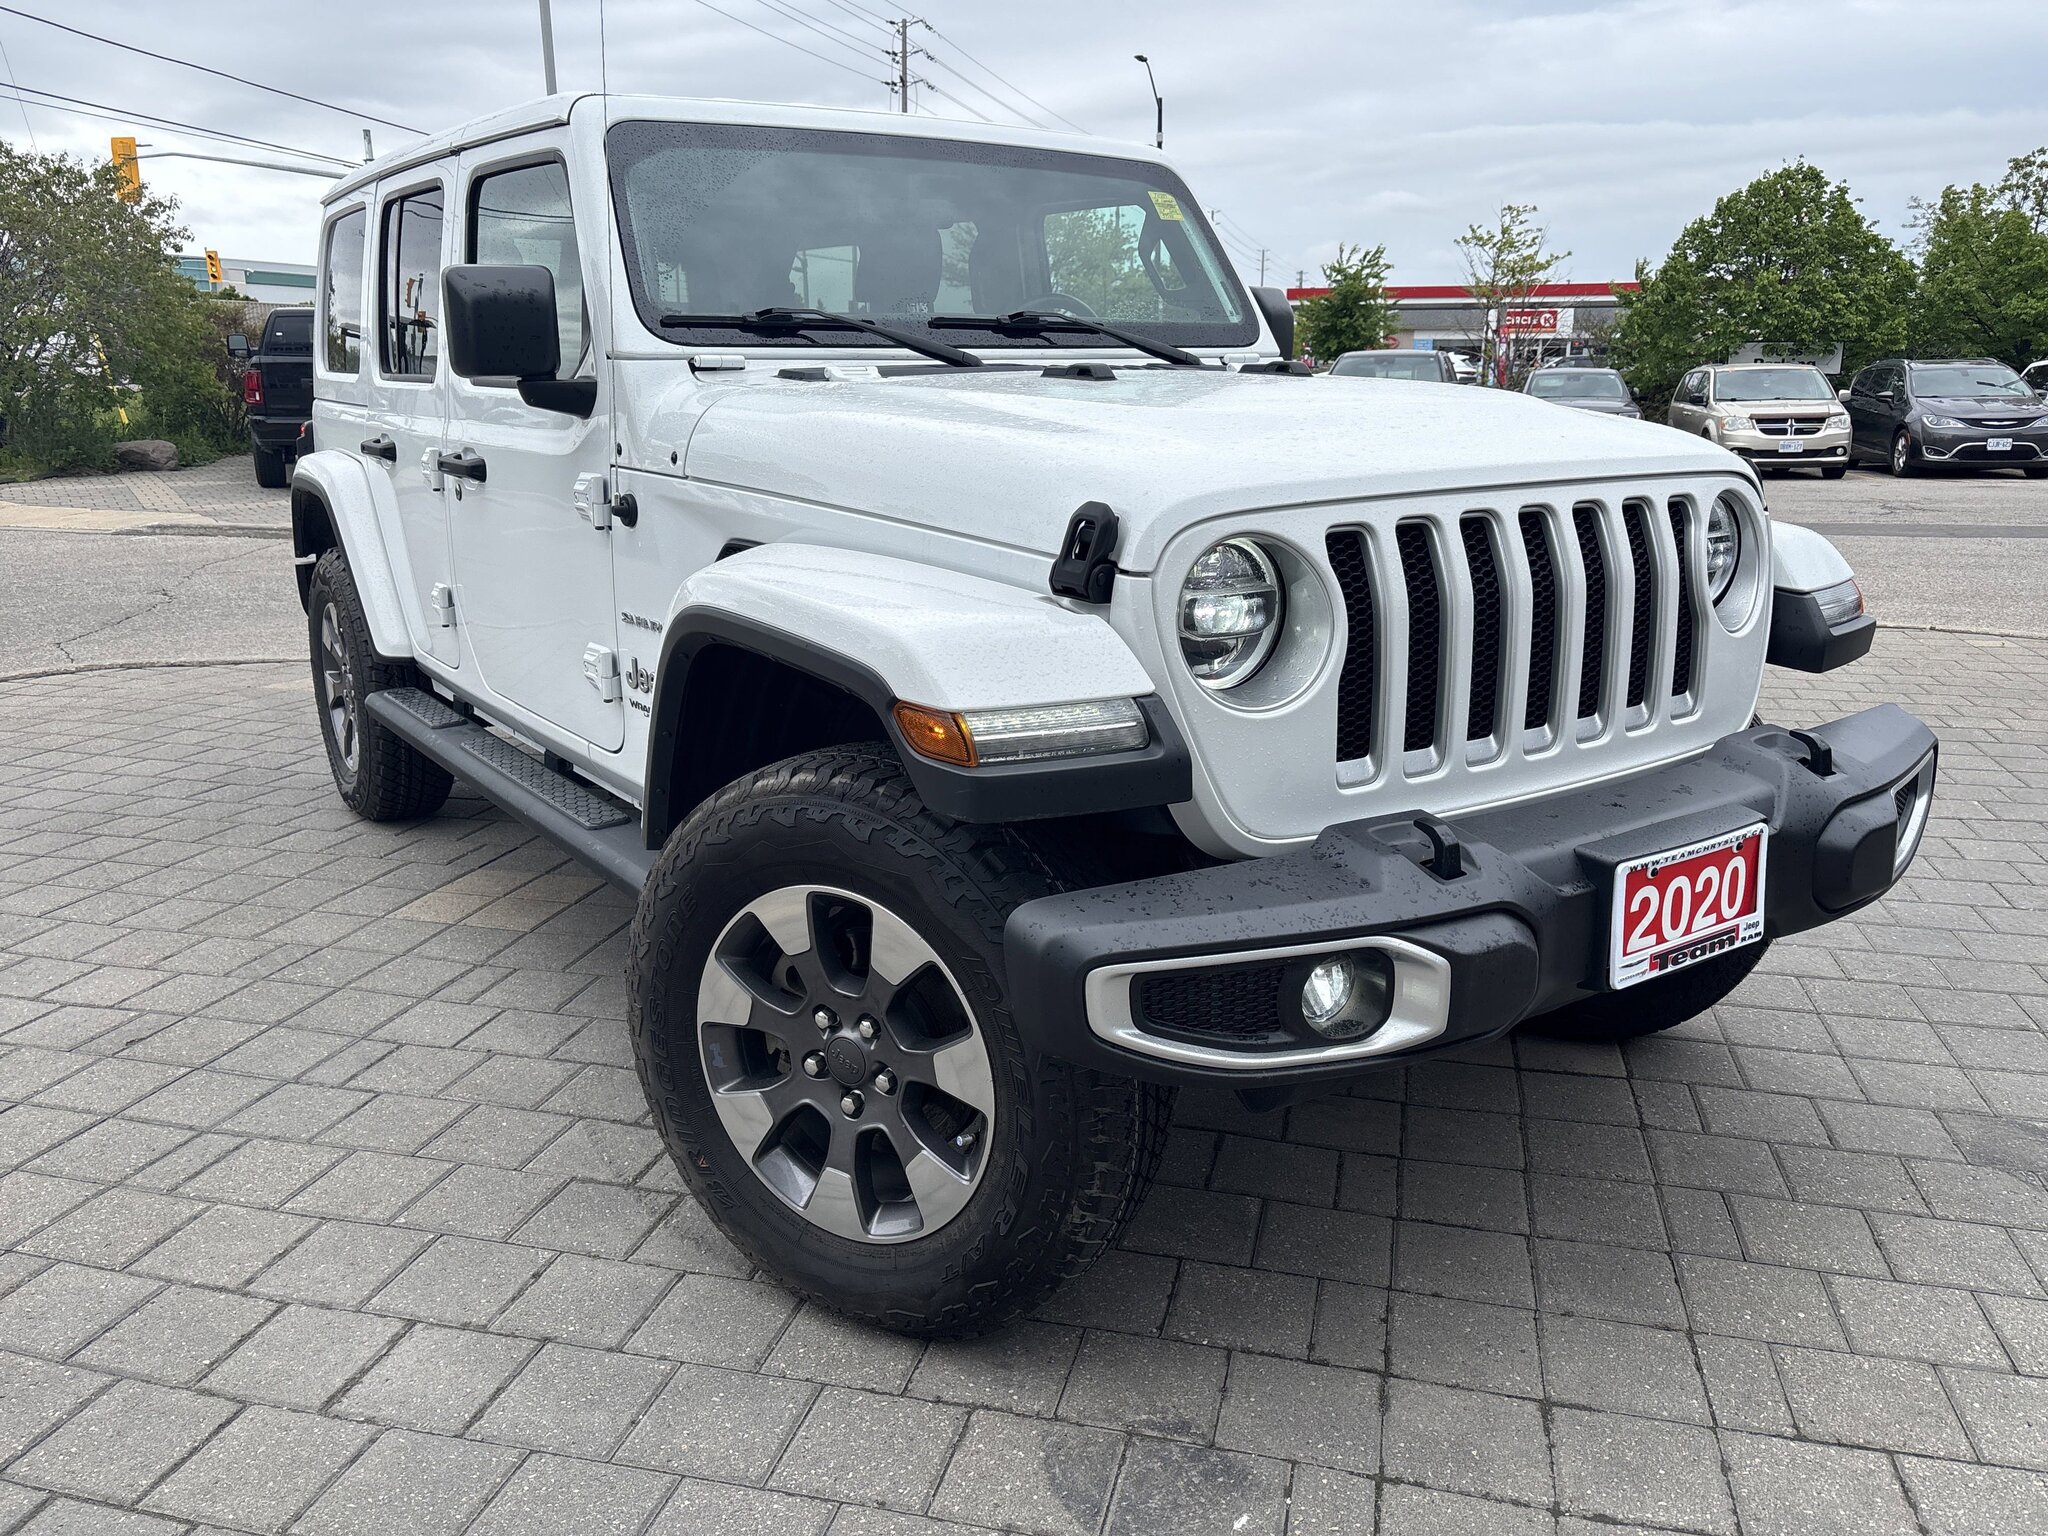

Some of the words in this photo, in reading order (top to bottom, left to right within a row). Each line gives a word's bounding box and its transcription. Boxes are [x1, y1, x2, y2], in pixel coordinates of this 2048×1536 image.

[1628, 828, 1765, 872] WWW.TEAMCHRYSLER.CA
[1626, 855, 1747, 954] 2020
[1743, 919, 1760, 932] Jeep
[1653, 928, 1737, 973] Team
[1740, 931, 1762, 944] RAM
[648, 884, 737, 1212] BRIDGESTONE
